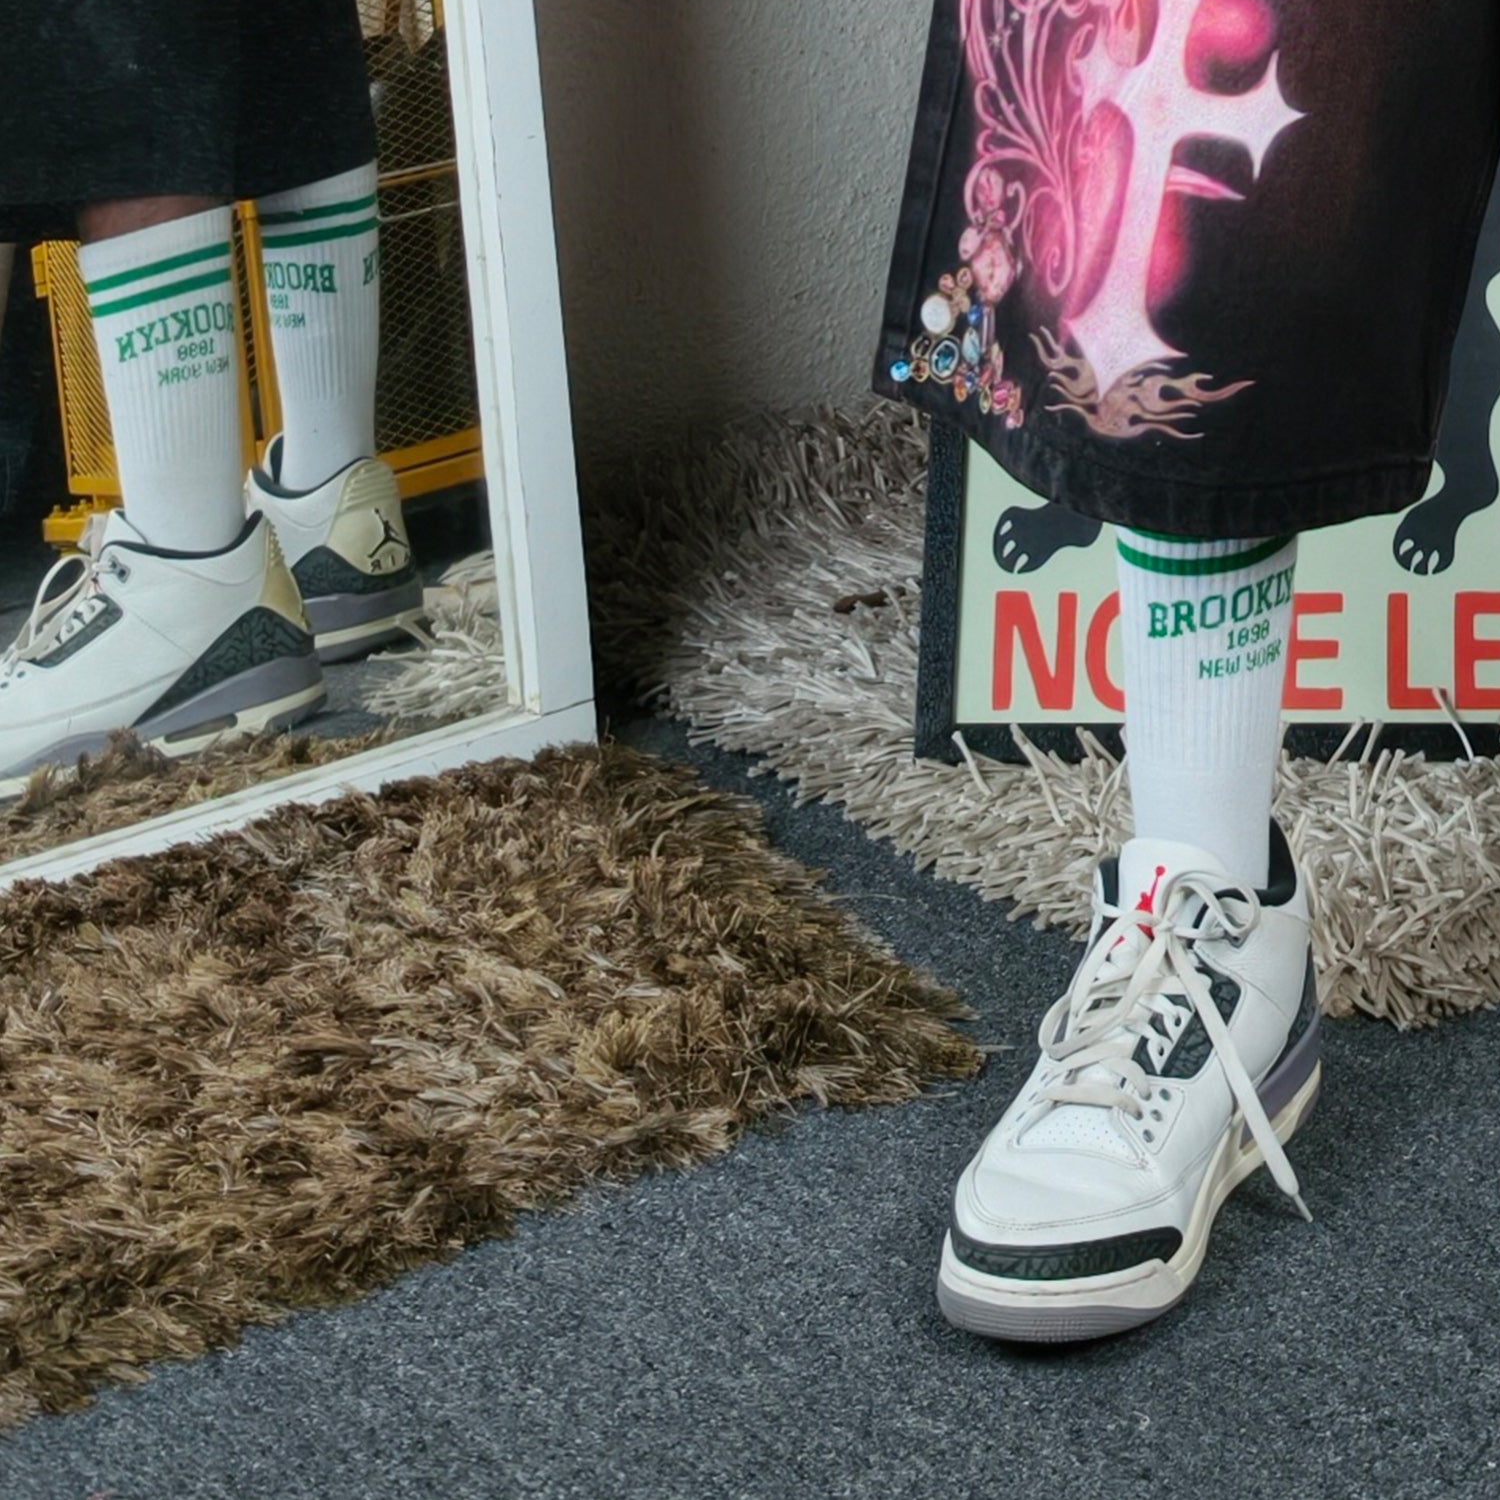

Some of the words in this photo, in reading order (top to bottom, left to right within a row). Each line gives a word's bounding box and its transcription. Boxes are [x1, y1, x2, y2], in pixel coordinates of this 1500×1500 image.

[1147, 562, 1296, 639] BROOKLY
[1227, 618, 1271, 650] 1898
[1198, 655, 1241, 680] NEW
[1246, 638, 1282, 673] YORK
